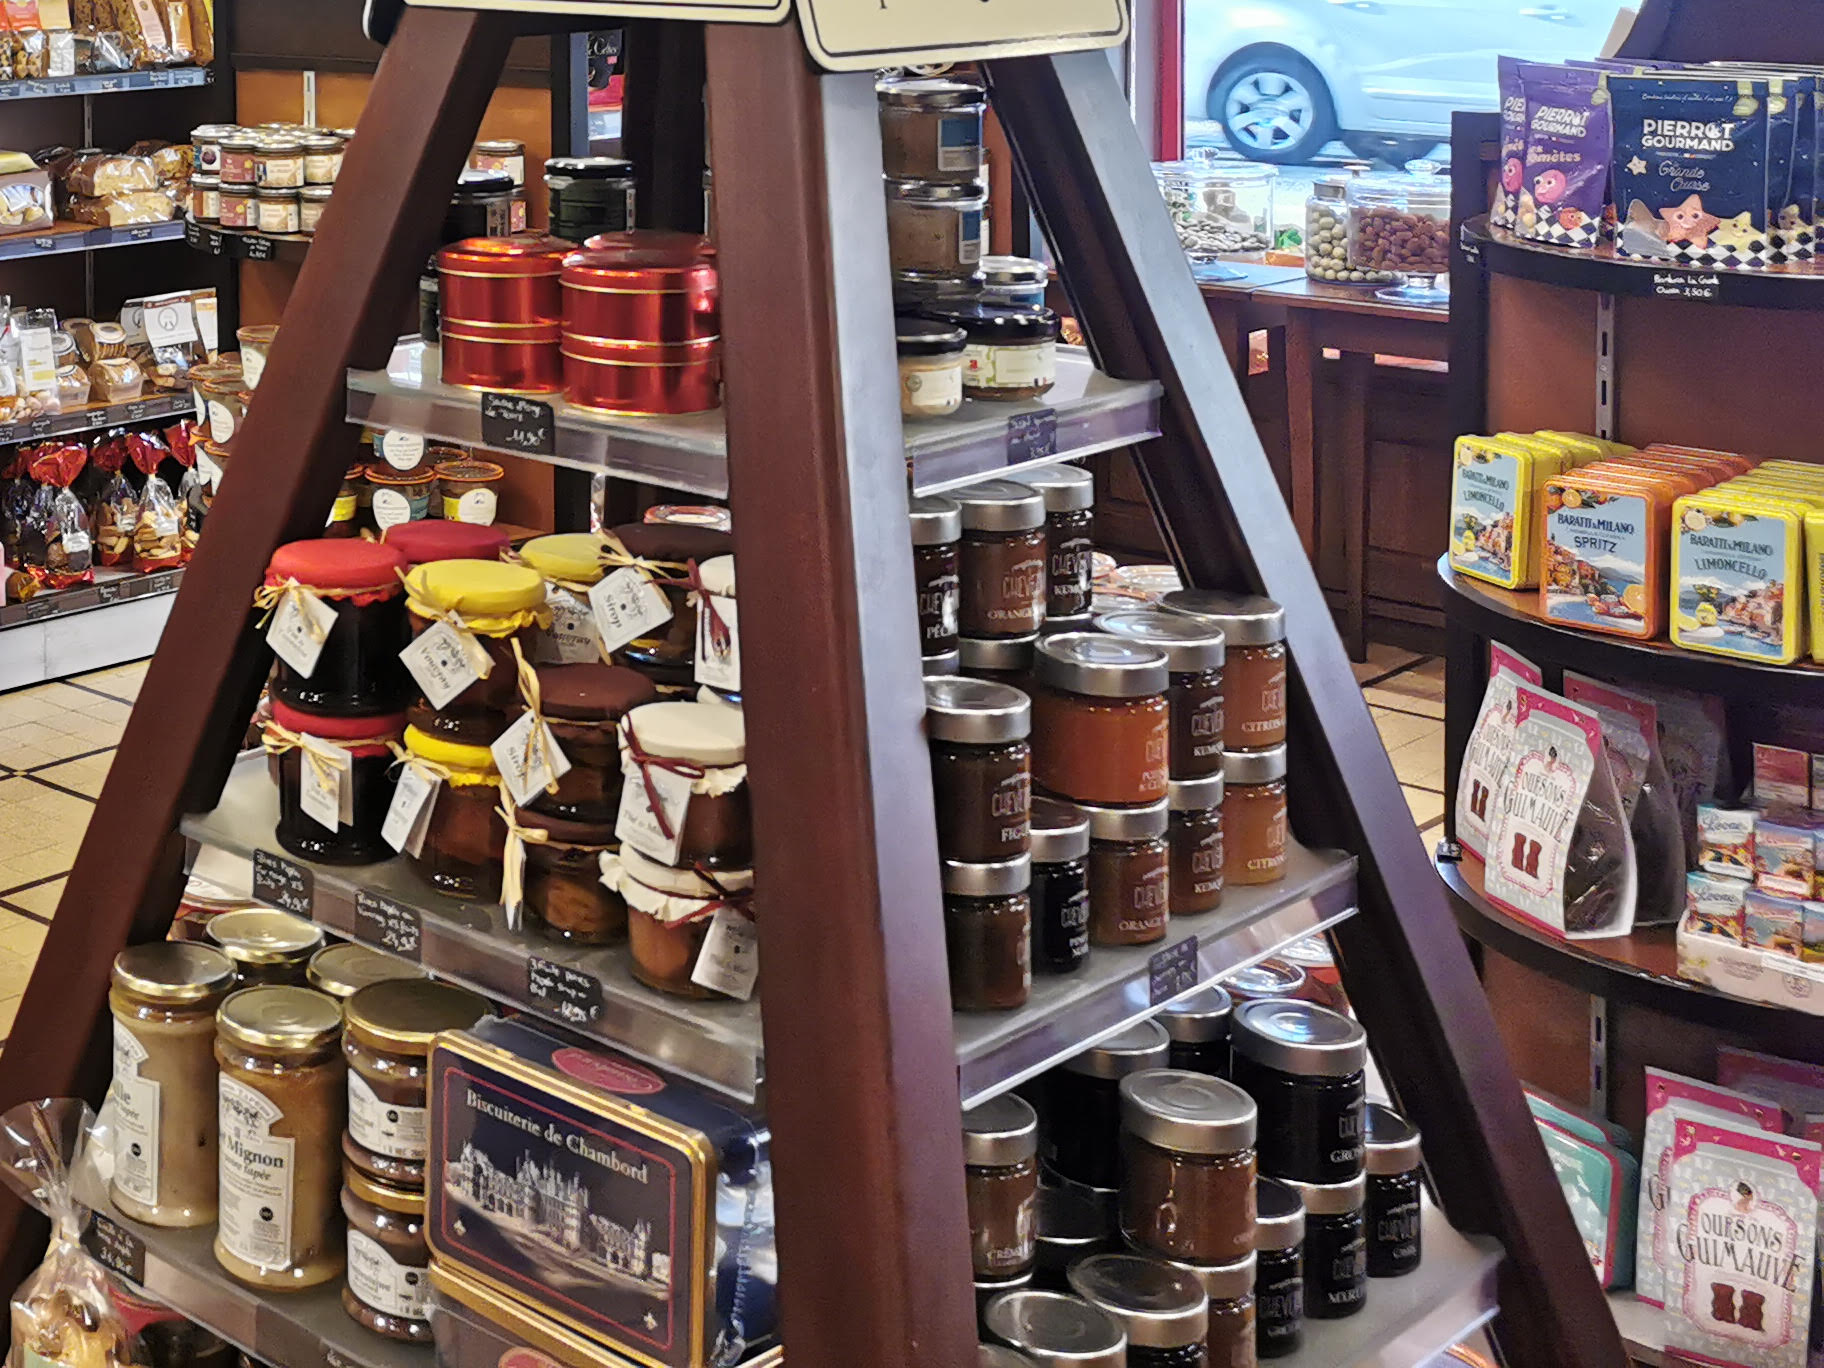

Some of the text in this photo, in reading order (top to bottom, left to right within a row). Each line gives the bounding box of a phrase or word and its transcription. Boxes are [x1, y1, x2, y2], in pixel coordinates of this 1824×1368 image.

[1530, 119, 1587, 138] GOURMAND
[1642, 118, 1735, 139] PIERROT
[1641, 135, 1735, 152] GOURMAND
[1463, 489, 1505, 512] LIMONCELLO
[1573, 534, 1619, 554] SPRITZ
[1694, 557, 1768, 581] LIMONCELLO
[466, 1087, 649, 1185] Biscuiterie de Chambord
[227, 1134, 285, 1169] Mignon
[1700, 1212, 1784, 1254] OURSONS
[1676, 1222, 1807, 1294] GUIMAUVE
